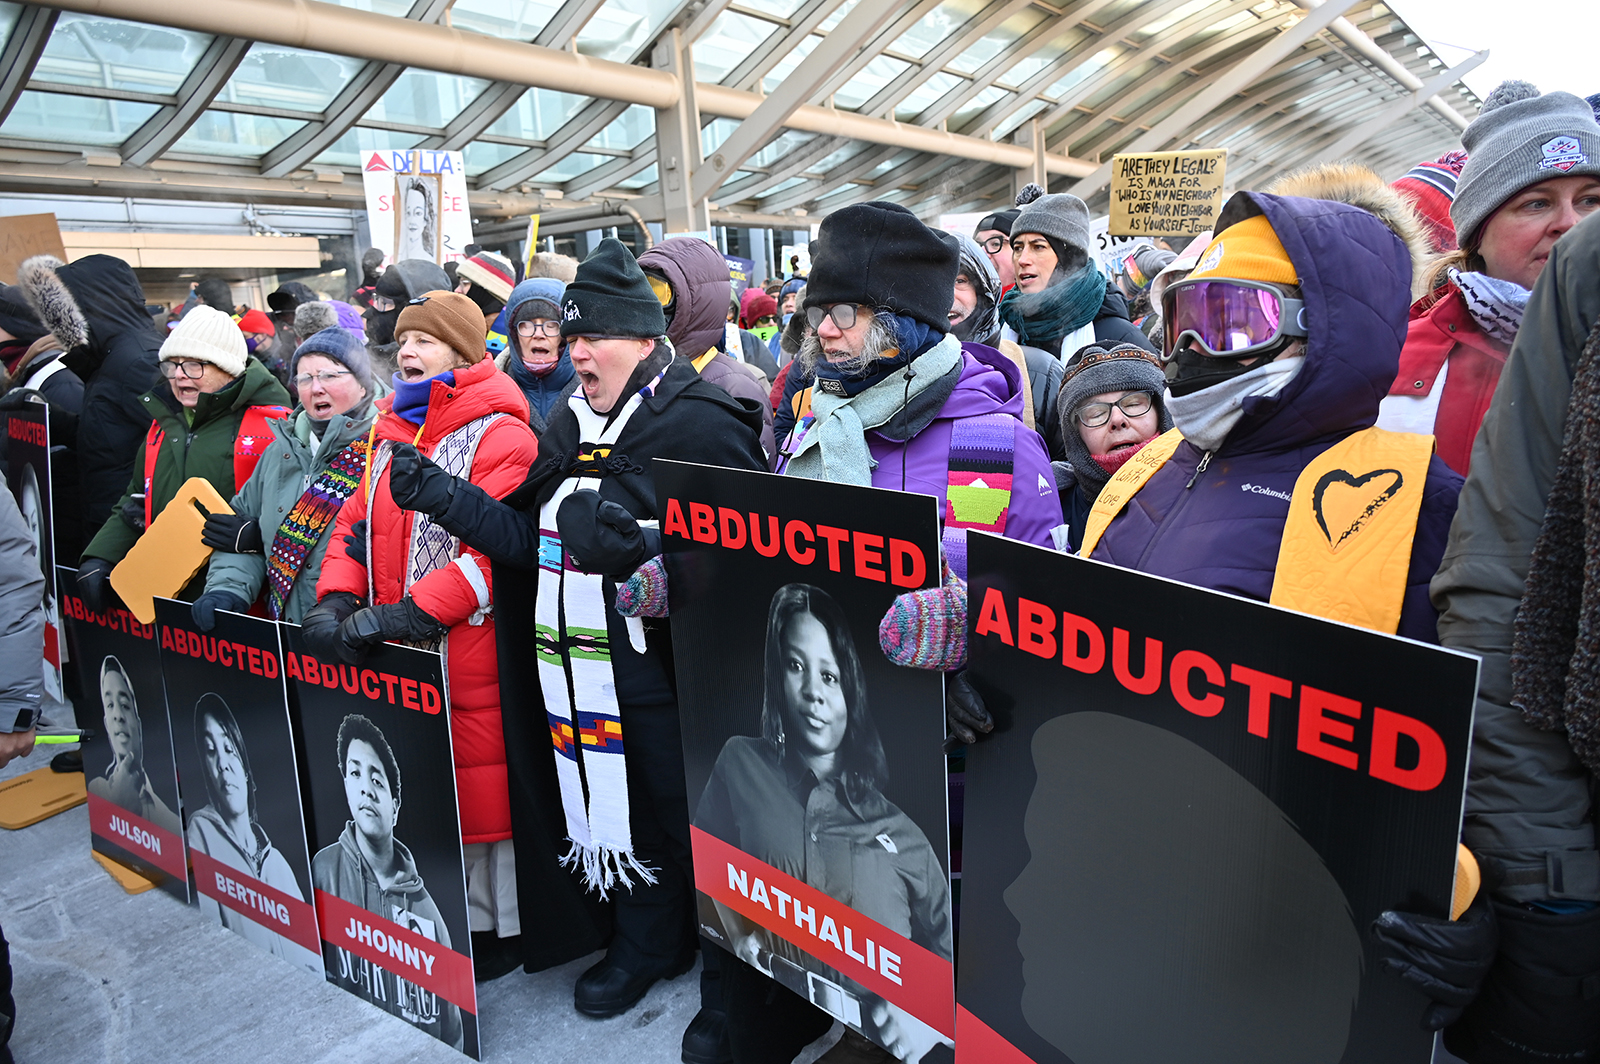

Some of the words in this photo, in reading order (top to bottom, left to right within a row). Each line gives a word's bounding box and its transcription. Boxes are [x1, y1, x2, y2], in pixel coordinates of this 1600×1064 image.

[1127, 177, 1143, 189] IS
[1147, 177, 1176, 188] MAGA
[1179, 177, 1201, 188] FOR
[1128, 202, 1151, 214] LOVE
[1151, 201, 1171, 216] YOUR
[1173, 203, 1213, 217] NEIGHBOR
[1139, 189, 1152, 201] IS
[1153, 189, 1169, 201] MY
[1129, 217, 1141, 230] AS
[8, 416, 47, 448] ABDUCTED
[664, 497, 927, 589] ABDUCTED
[161, 624, 279, 680] ABDUCTED
[286, 651, 442, 716] ABDUCTED
[974, 586, 1448, 792] ABDUCTED
[109, 814, 162, 856] JULSON
[214, 871, 291, 927] BERTING
[726, 861, 903, 987] NATHALIE
[344, 917, 436, 977] JHONNY
